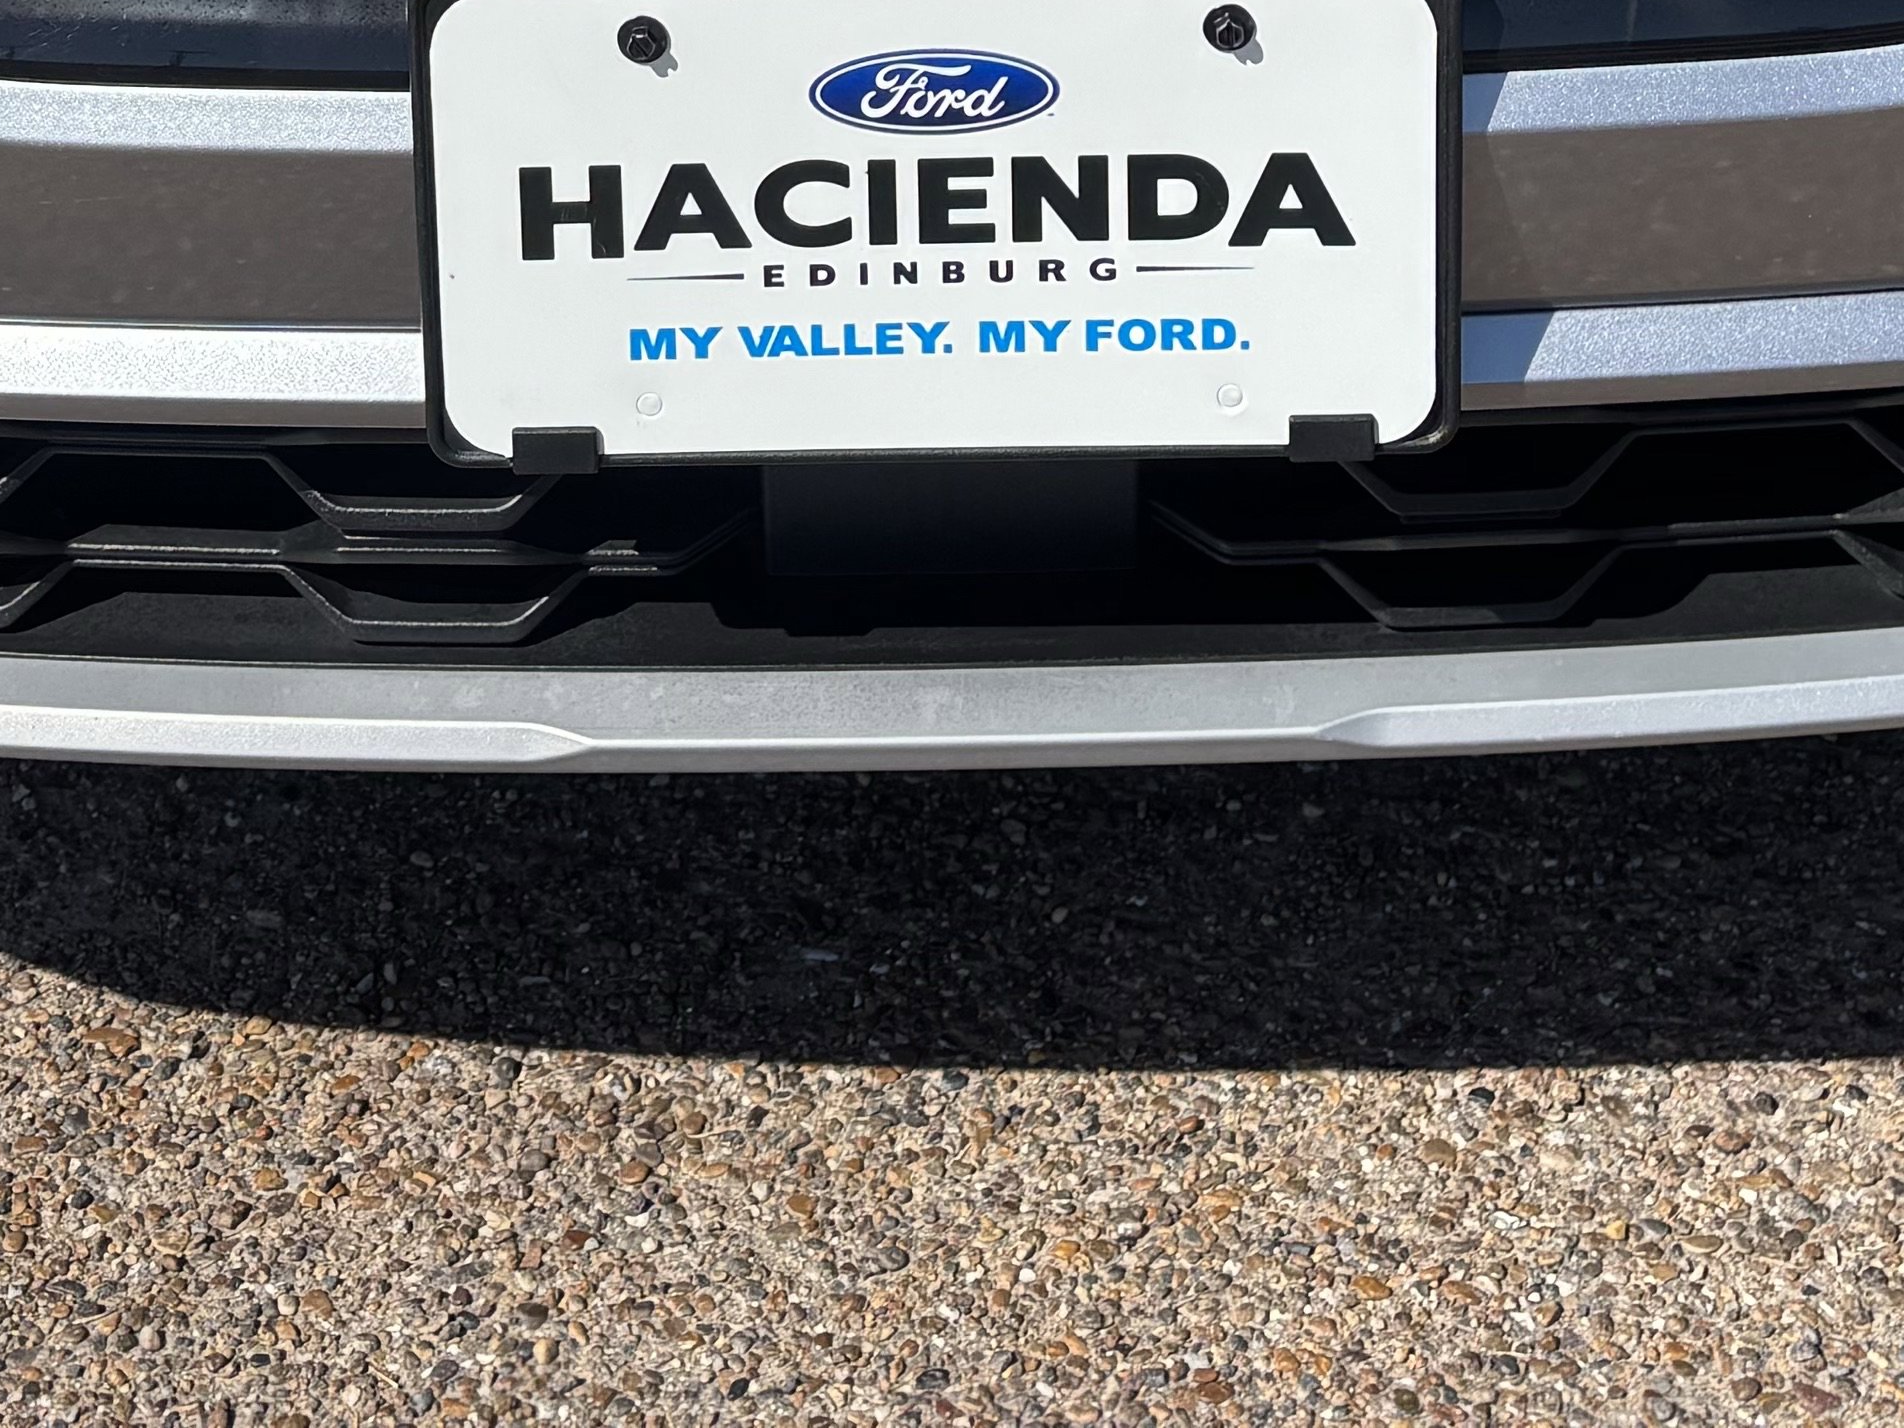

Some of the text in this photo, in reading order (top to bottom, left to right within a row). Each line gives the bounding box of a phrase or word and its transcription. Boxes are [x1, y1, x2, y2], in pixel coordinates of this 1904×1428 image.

[860, 61, 1006, 121] Ford
[518, 152, 1357, 261] HACIENDA
[762, 257, 1118, 289] EDINBURG
[628, 317, 1251, 362] MY VALLEY. MY FORD.
